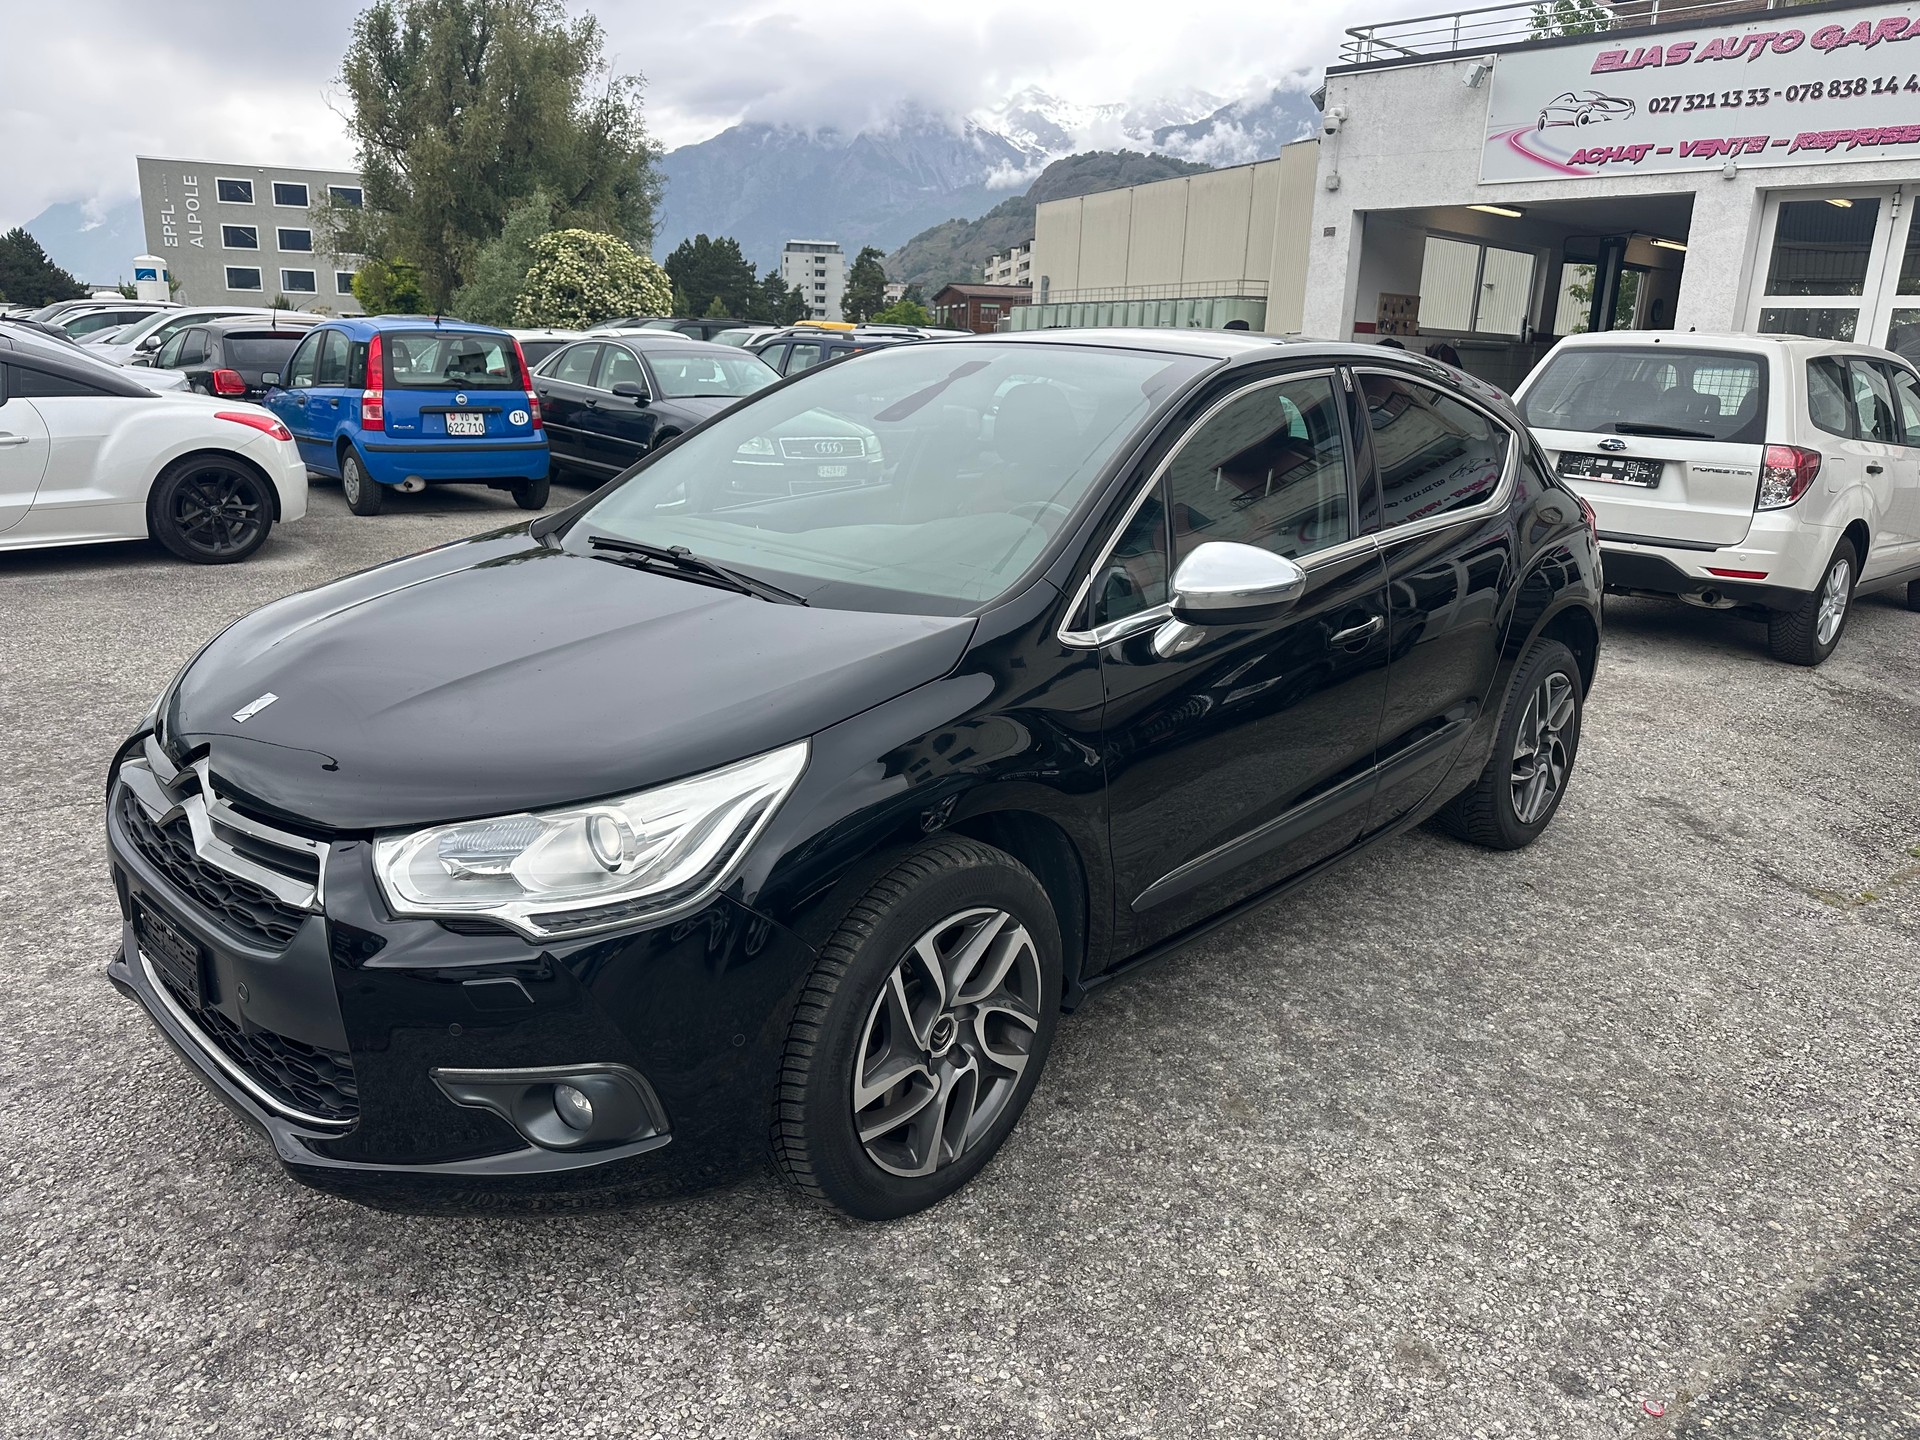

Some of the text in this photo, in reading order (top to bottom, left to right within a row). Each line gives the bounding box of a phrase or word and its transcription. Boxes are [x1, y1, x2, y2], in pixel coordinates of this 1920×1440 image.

[1591, 41, 1697, 74] ELIAS
[1694, 29, 1805, 63] AUTO
[1649, 96, 1682, 114] 027
[1683, 93, 1716, 112] 321
[1720, 90, 1743, 108] 13
[1745, 88, 1770, 106] 33
[1786, 81, 1824, 102] 078
[1827, 77, 1867, 98] 838
[1871, 75, 1898, 94] 14
[1903, 74, 1920, 93] 4
[1566, 144, 1654, 166] ACHAT
[1680, 136, 1770, 160] VENTE
[1787, 125, 1920, 155] REPRISE
[161, 204, 178, 247] EPFL
[183, 175, 204, 248] ALPOLE
[448, 423, 484, 433] 622 710
[460, 413, 469, 421] VD
[513, 412, 525, 423] CH
[1692, 466, 1753, 476] FORESTER
